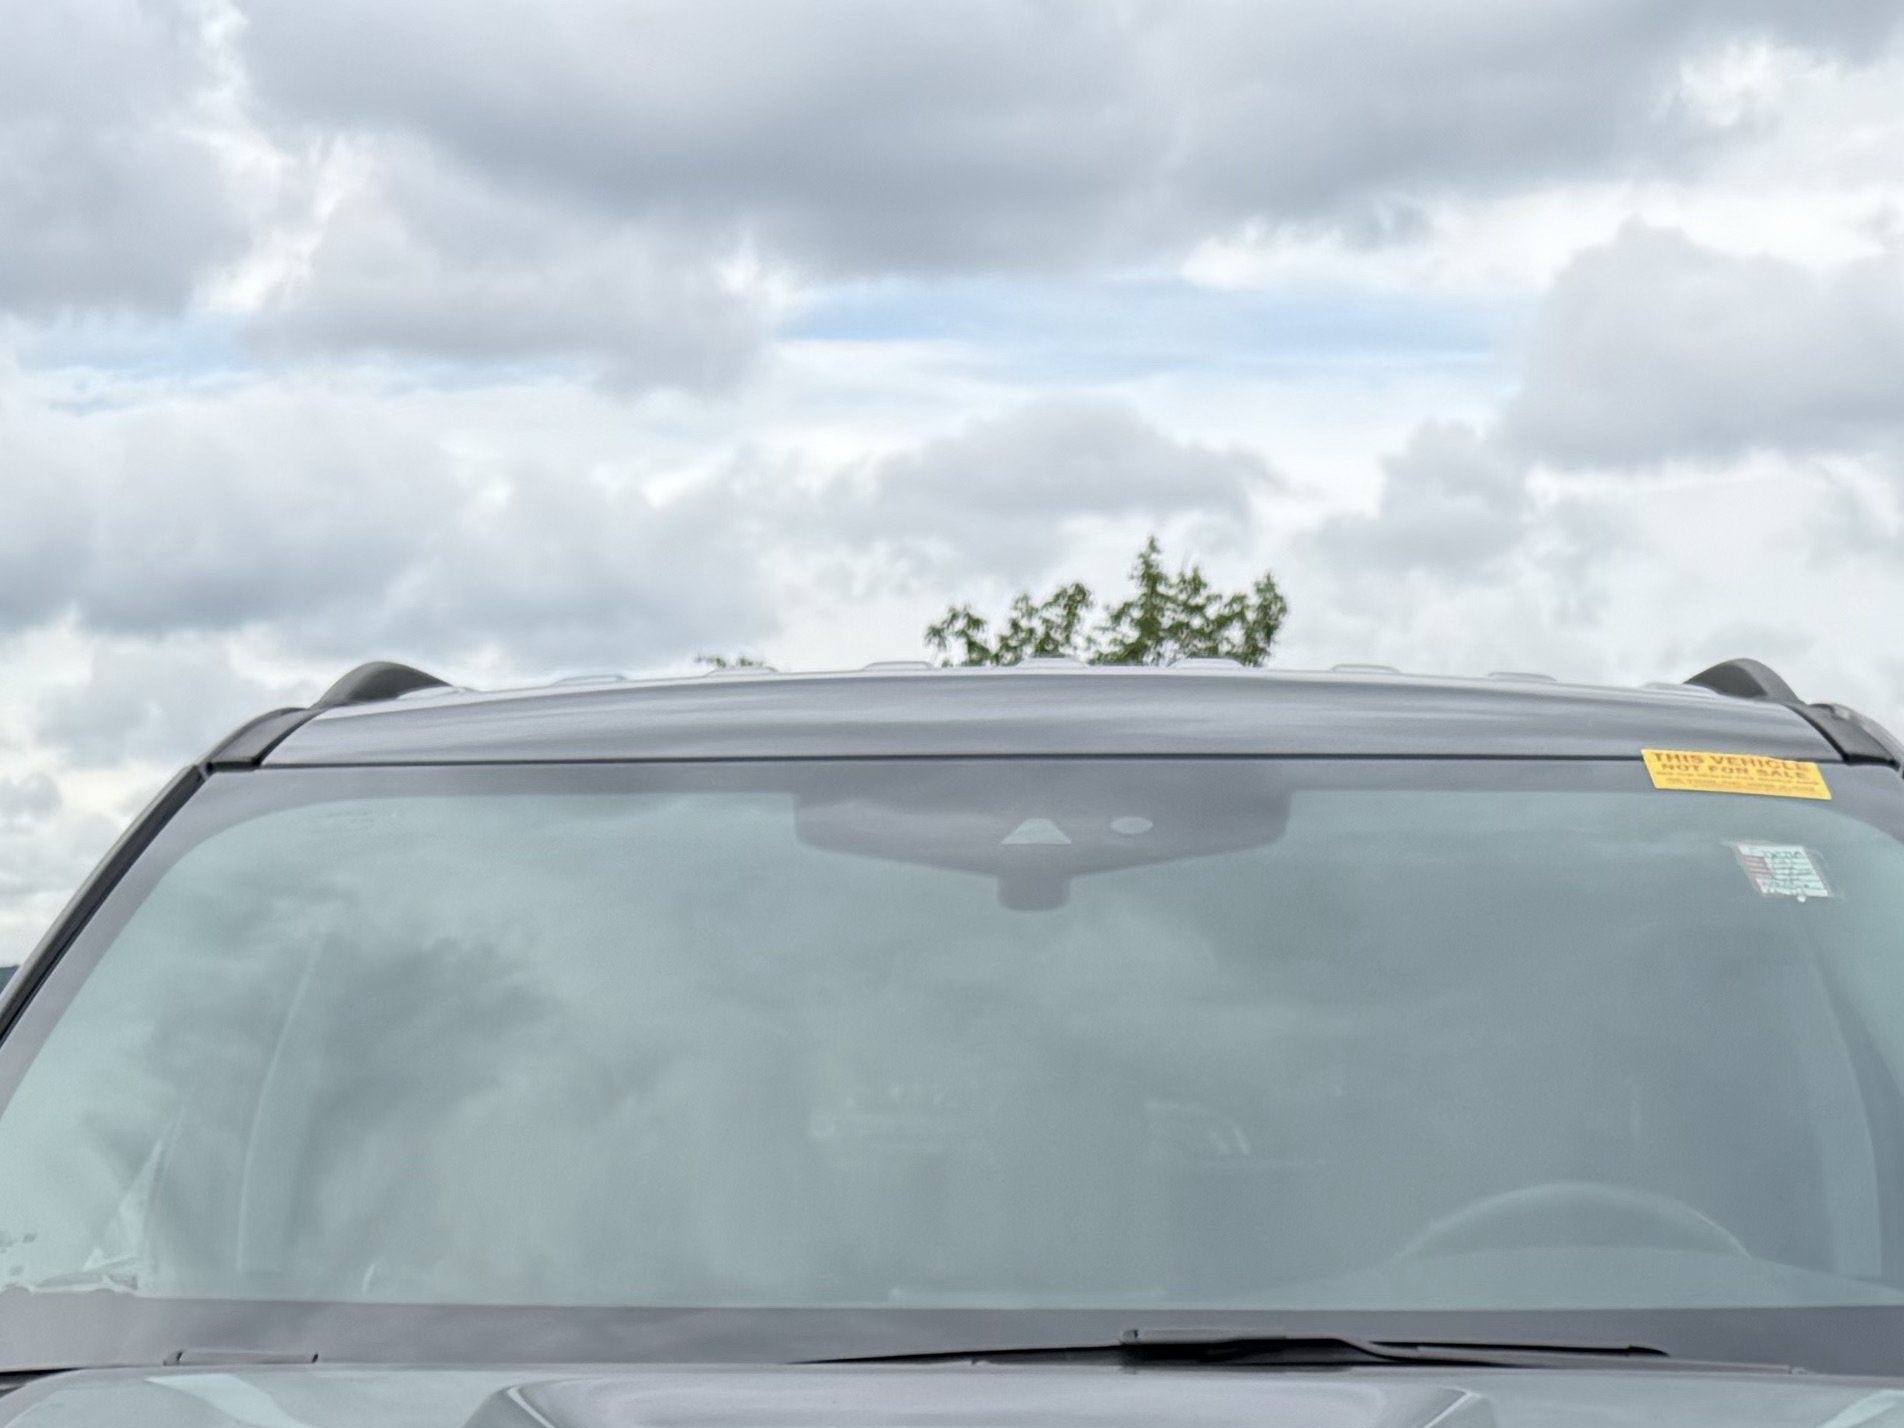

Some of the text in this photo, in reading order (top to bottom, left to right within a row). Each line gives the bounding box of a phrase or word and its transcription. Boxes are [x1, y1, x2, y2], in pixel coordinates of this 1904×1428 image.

[1653, 752, 1810, 772] THIS VEHICLE
[1661, 763, 1700, 772] NOT
[1708, 765, 1749, 775] FOR
[1755, 768, 1810, 779] SALE
